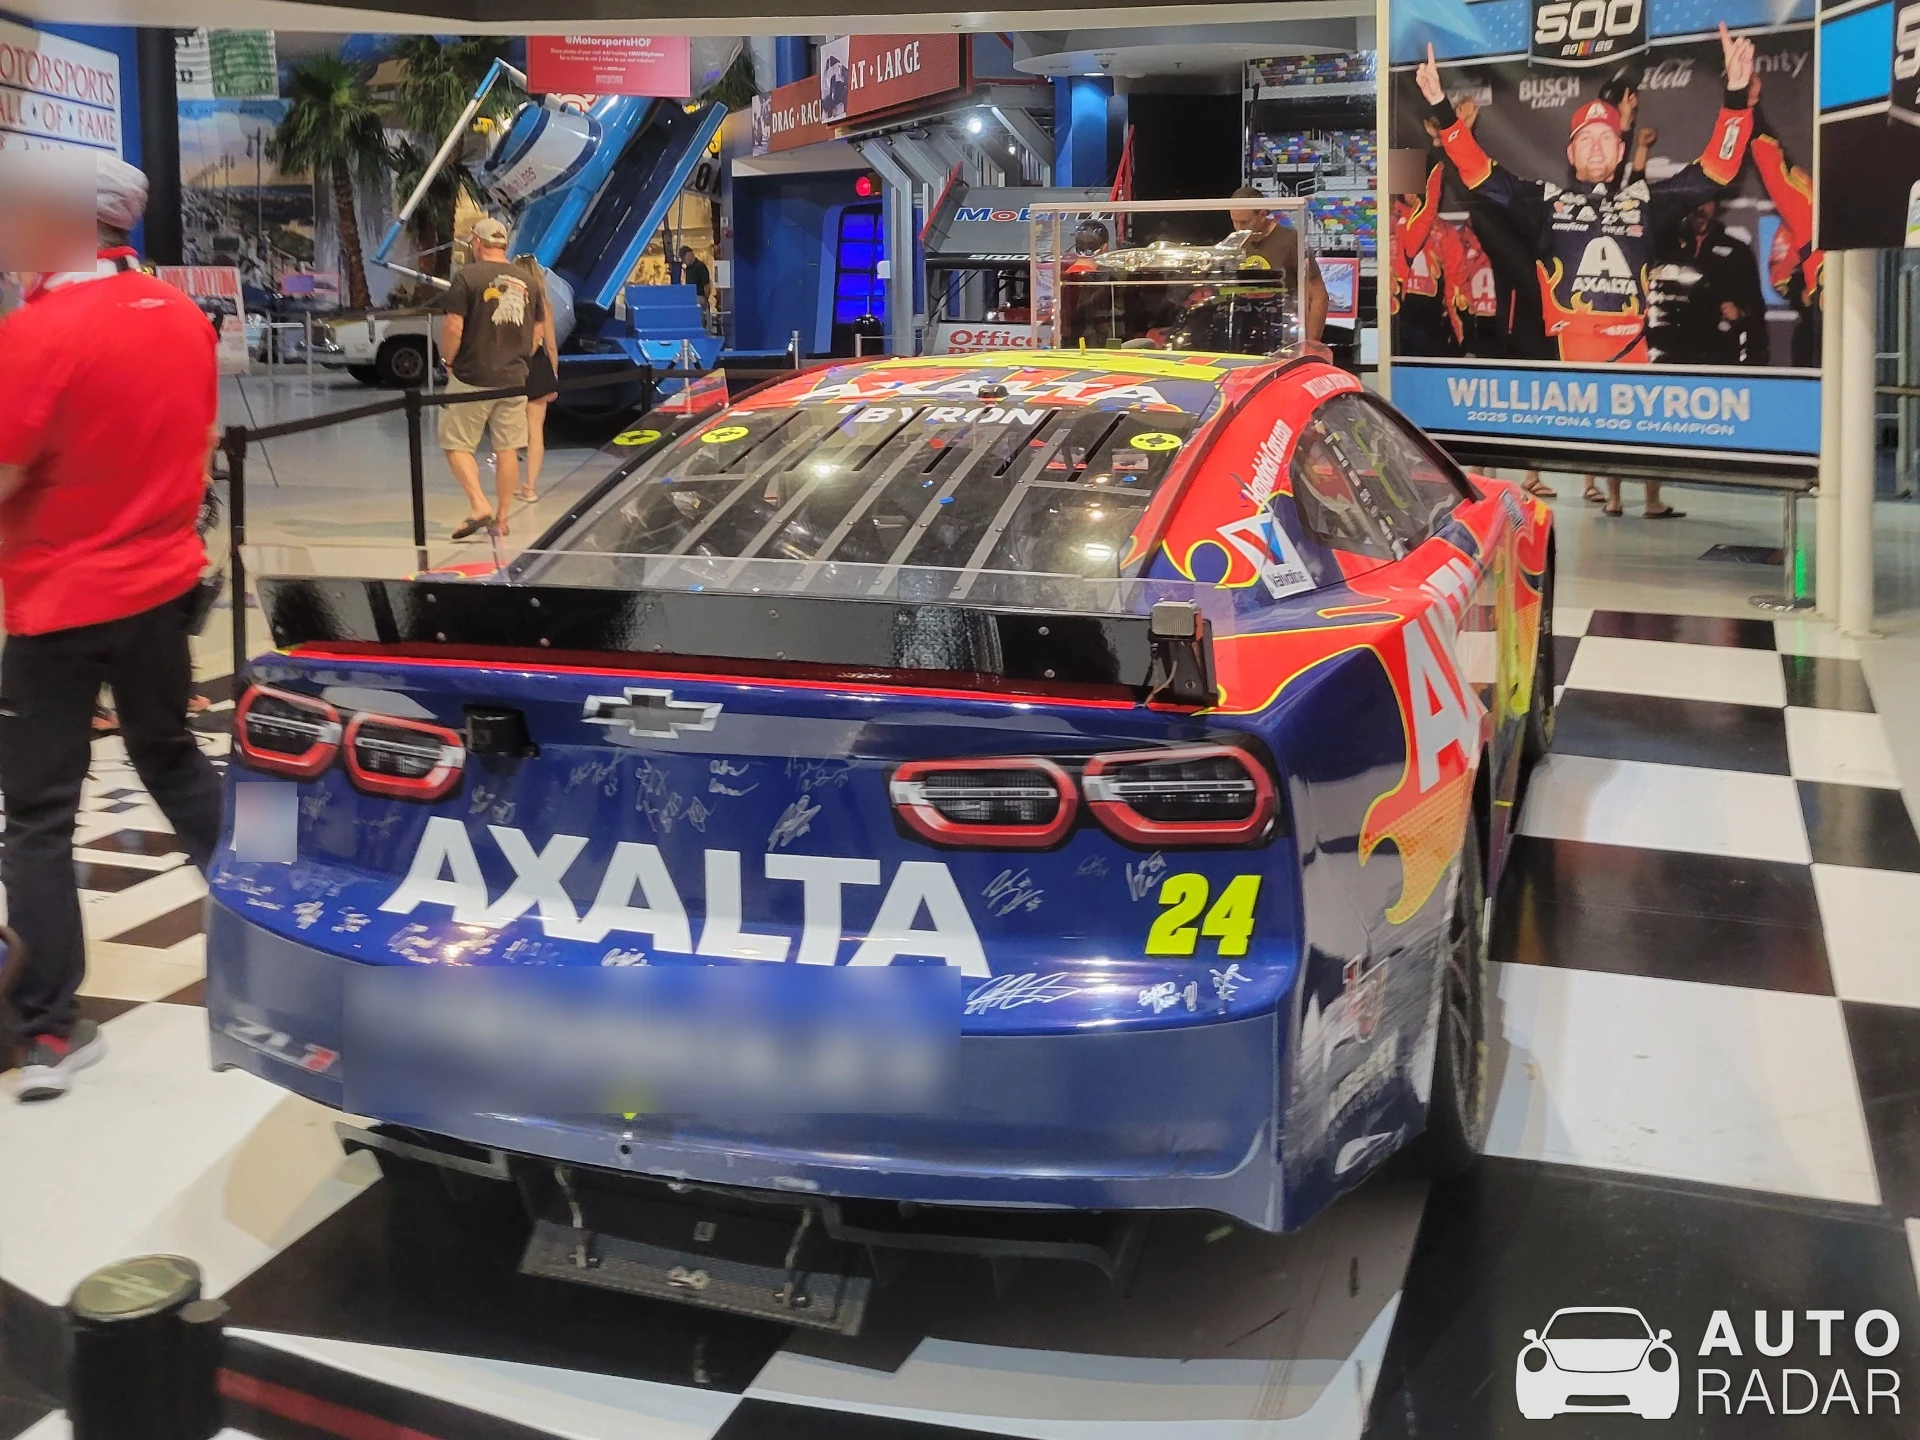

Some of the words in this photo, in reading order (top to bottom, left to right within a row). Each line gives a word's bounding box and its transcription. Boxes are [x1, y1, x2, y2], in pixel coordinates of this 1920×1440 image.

[1535, 0, 1643, 44] 500
[851, 60, 866, 91] AT
[877, 41, 921, 83] LARGE
[1519, 75, 1580, 101] BUSCH
[1532, 97, 1567, 109] LIGHT
[42, 101, 64, 132] OF
[77, 108, 116, 143] FAME
[772, 108, 795, 133] DRAG
[1571, 276, 1638, 296] AXALTA
[949, 329, 1042, 348] Office
[787, 380, 1170, 405] AXALTA
[1447, 376, 1598, 414] WILLIAM
[1610, 383, 1750, 422] BYRON
[853, 406, 1045, 426] BYRON
[1466, 410, 1508, 423] 2025
[1512, 413, 1592, 429] DAYTONA
[1596, 416, 1632, 430] 500
[1636, 419, 1735, 436] CHAMPION
[378, 815, 992, 980] AXALTA
[1144, 872, 1262, 956] 24
